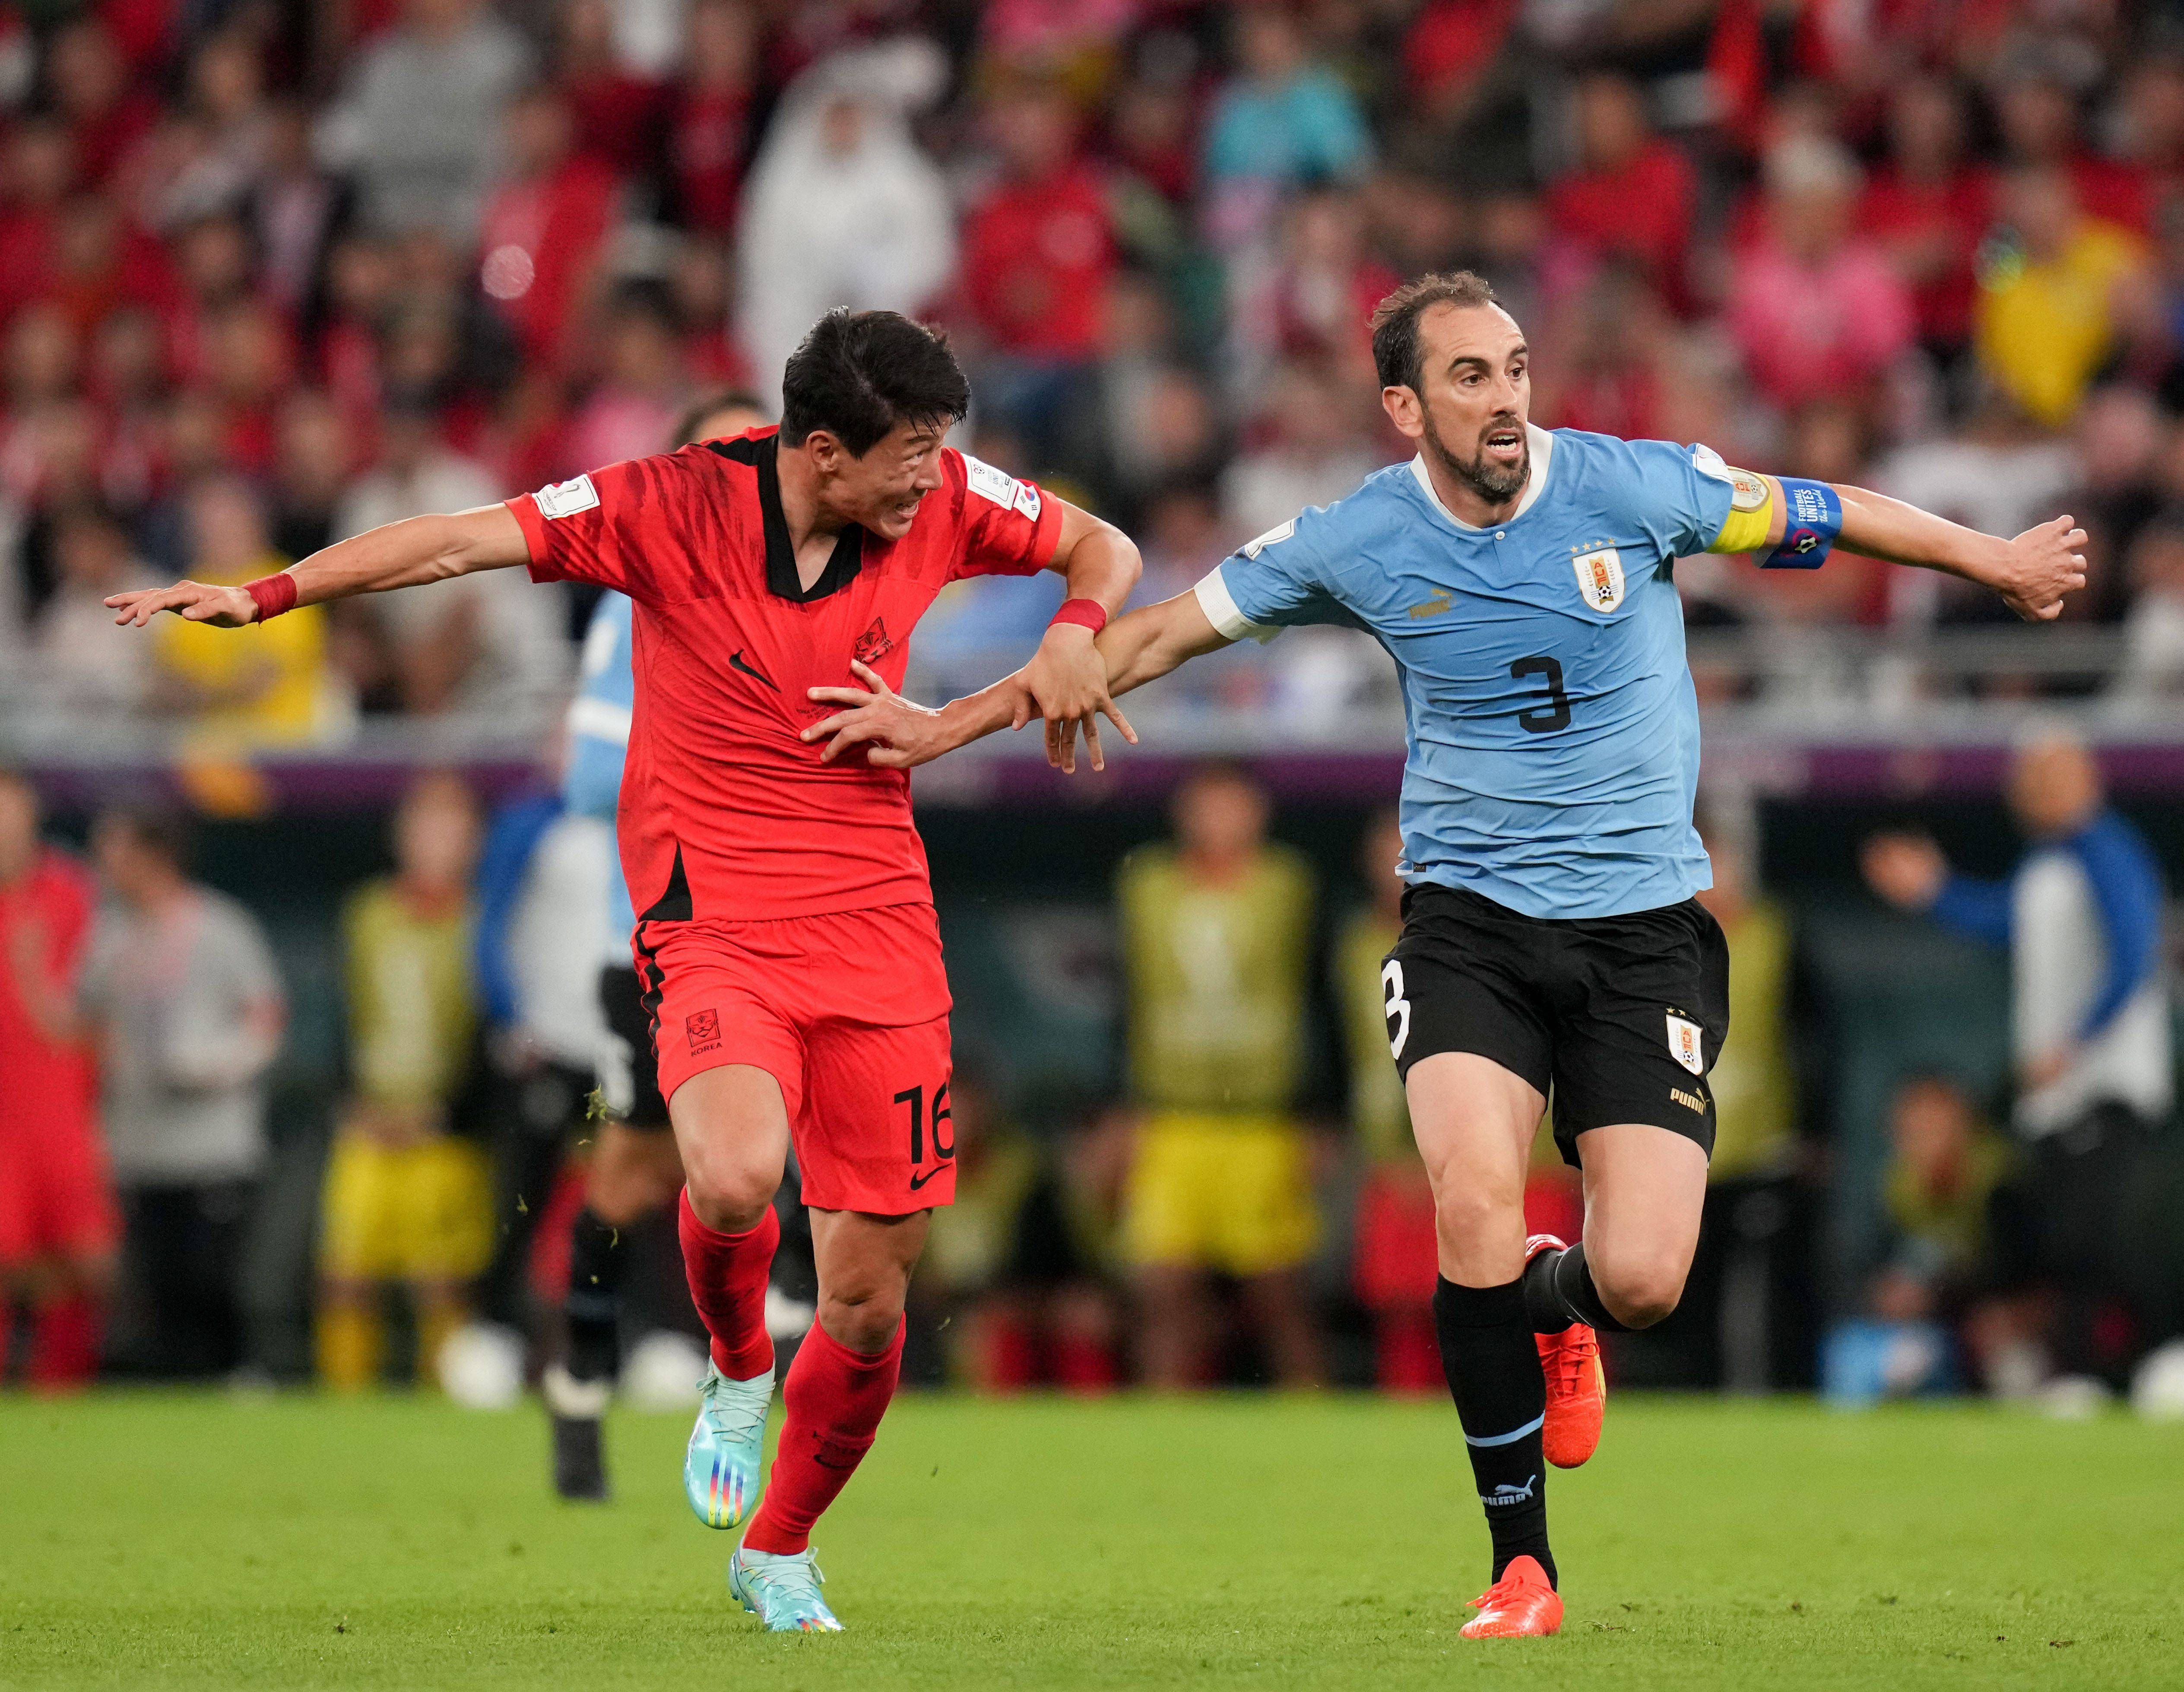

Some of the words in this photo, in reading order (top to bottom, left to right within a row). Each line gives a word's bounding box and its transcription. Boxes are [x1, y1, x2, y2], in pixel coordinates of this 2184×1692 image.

[1735, 483, 1750, 492] AUF
[1811, 489, 1827, 508] World
[1793, 489, 1806, 521] FOOTBALL
[1800, 489, 1818, 522] UNITES
[1819, 509, 1828, 523] the
[1594, 562, 1607, 585] AUF
[1510, 657, 1571, 734] 3
[1382, 959, 1411, 1060] 3
[691, 1042, 723, 1057] KOREA
[1683, 1031, 1692, 1049] AUF
[1670, 1087, 1704, 1115] PUMA
[894, 1082, 954, 1164] 16
